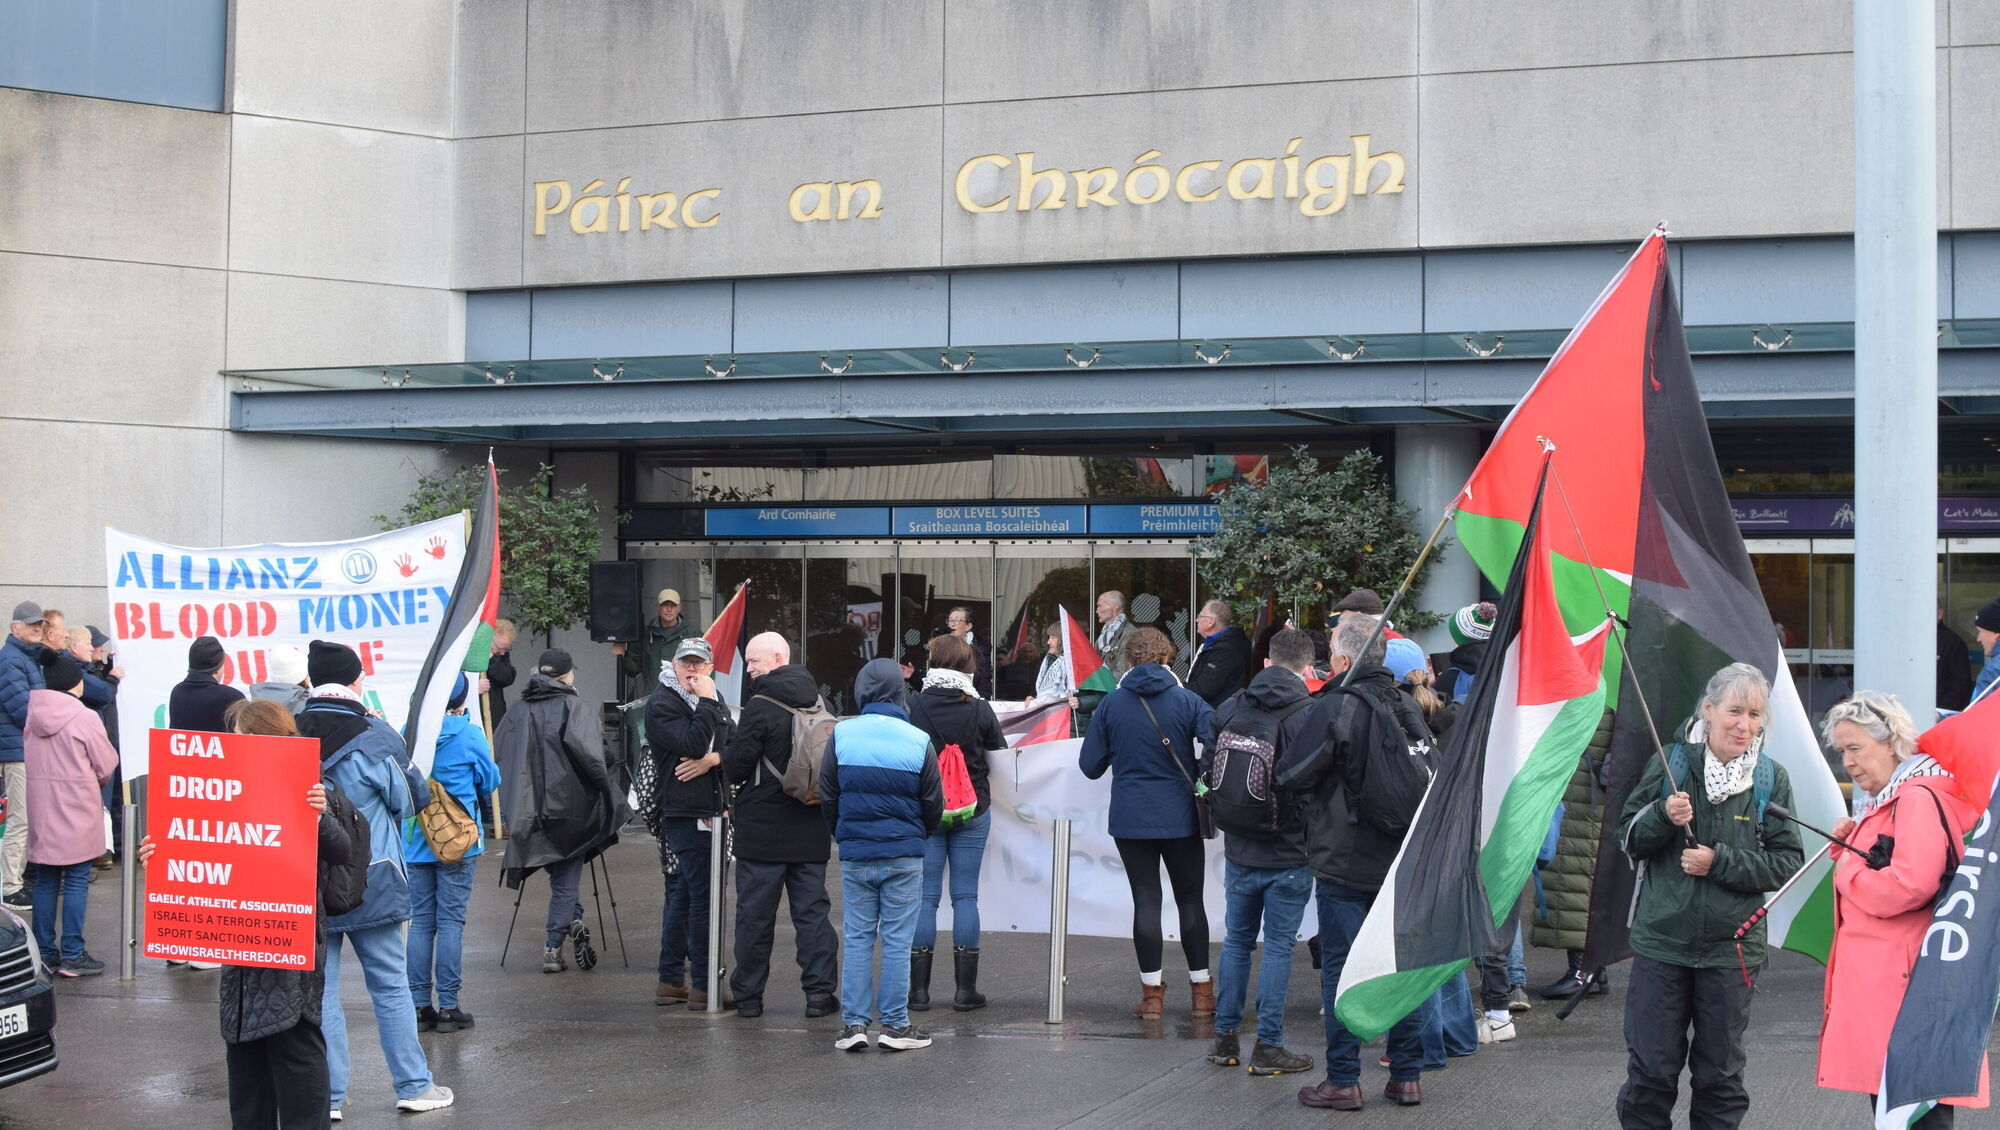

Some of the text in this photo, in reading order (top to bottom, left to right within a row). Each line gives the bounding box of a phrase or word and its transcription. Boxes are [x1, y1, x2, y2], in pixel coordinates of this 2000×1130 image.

[787, 179, 884, 222] an
[758, 509, 836, 520] Ard Comhairle
[936, 506, 1041, 519] BOX LEVEL SUITES
[1140, 505, 1199, 517] PREMIUM
[1749, 508, 1788, 519] Brilliant!
[1943, 507, 1998, 518] Let's Make
[909, 519, 1069, 533] Sraitheanna Boscaleibhéal
[116, 550, 322, 590] ALLIANZ
[114, 600, 277, 640] BLOOD
[170, 733, 225, 759] GAA
[169, 775, 242, 802] DROP
[167, 817, 282, 847] ALLIANZ
[167, 859, 233, 886] NOW
[149, 892, 313, 915] GAELIC ATHLETIC ASSOCIATION
[153, 910, 298, 931] ISRAEL IS A TERROR STATE
[157, 927, 293, 947] SPORT SANCTIONS NOW
[147, 942, 307, 966] #SHOWISRAELTHEREDCARD
